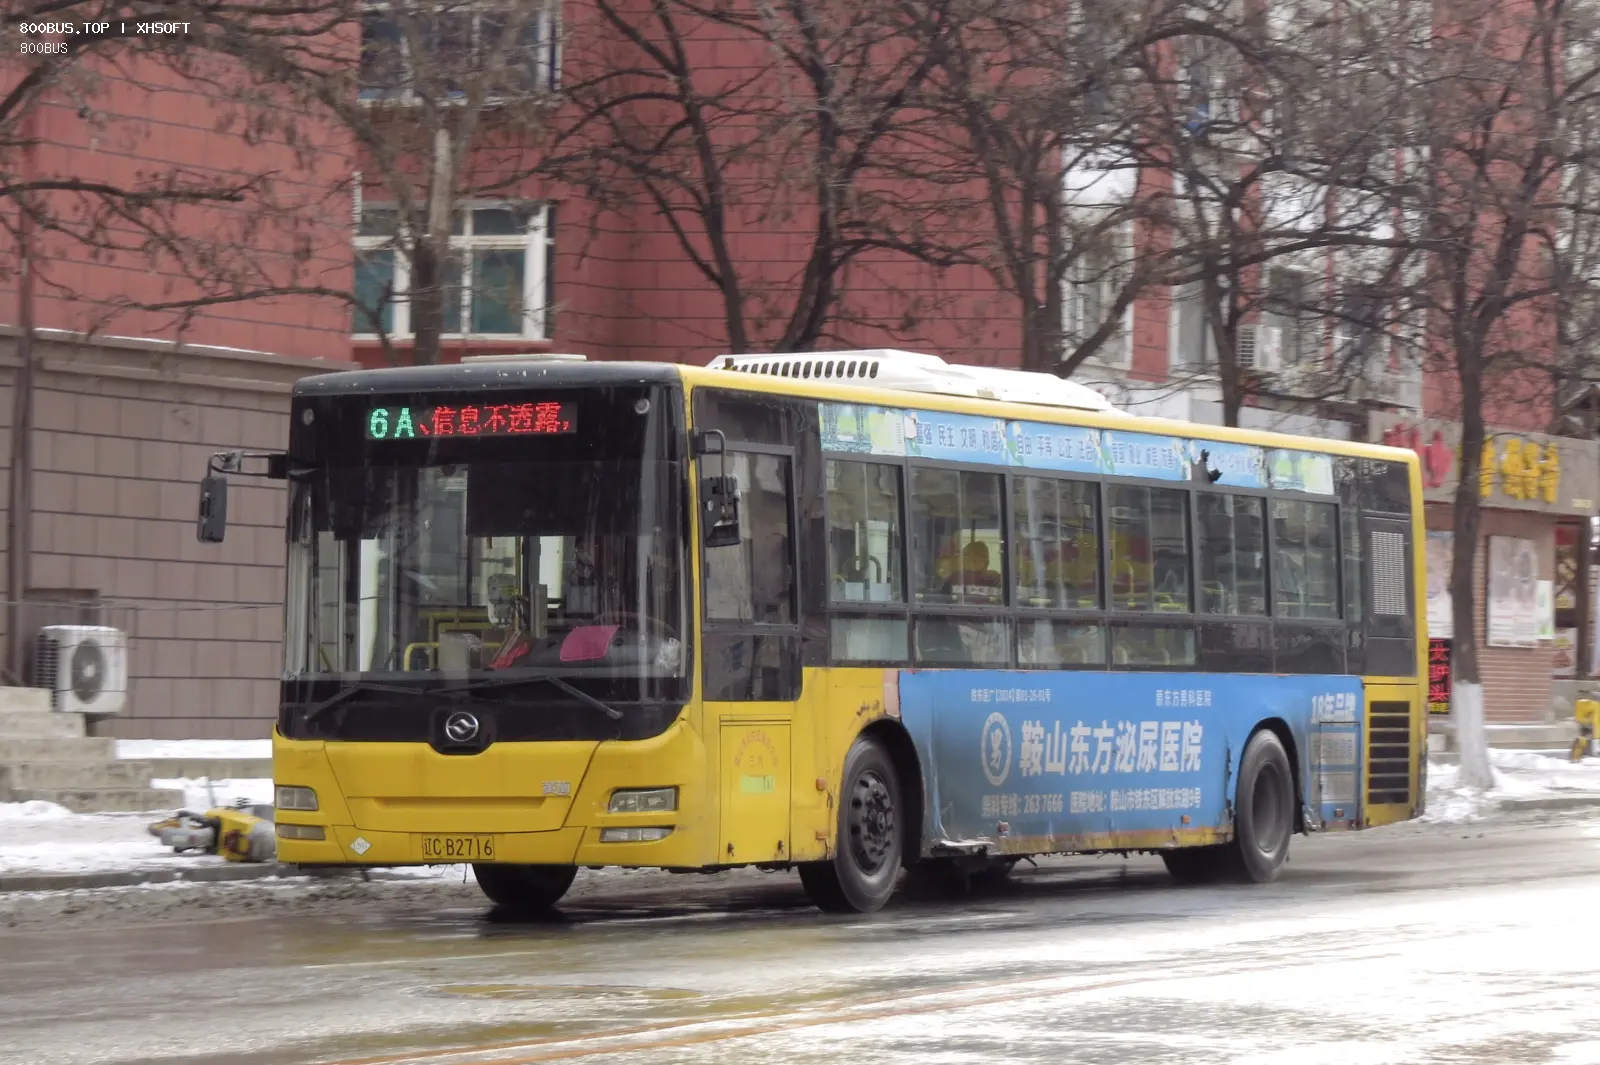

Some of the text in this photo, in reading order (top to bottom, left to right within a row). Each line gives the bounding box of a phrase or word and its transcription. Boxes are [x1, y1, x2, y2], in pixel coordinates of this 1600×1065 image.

[369, 407, 415, 439] 6A
[937, 424, 955, 448] 民主
[960, 426, 977, 450] 文明
[1017, 433, 1032, 455] 自由
[1037, 435, 1052, 458] 平等
[1058, 436, 1073, 459] 公正
[1019, 719, 1204, 776] 鞍山东方泌尿医院
